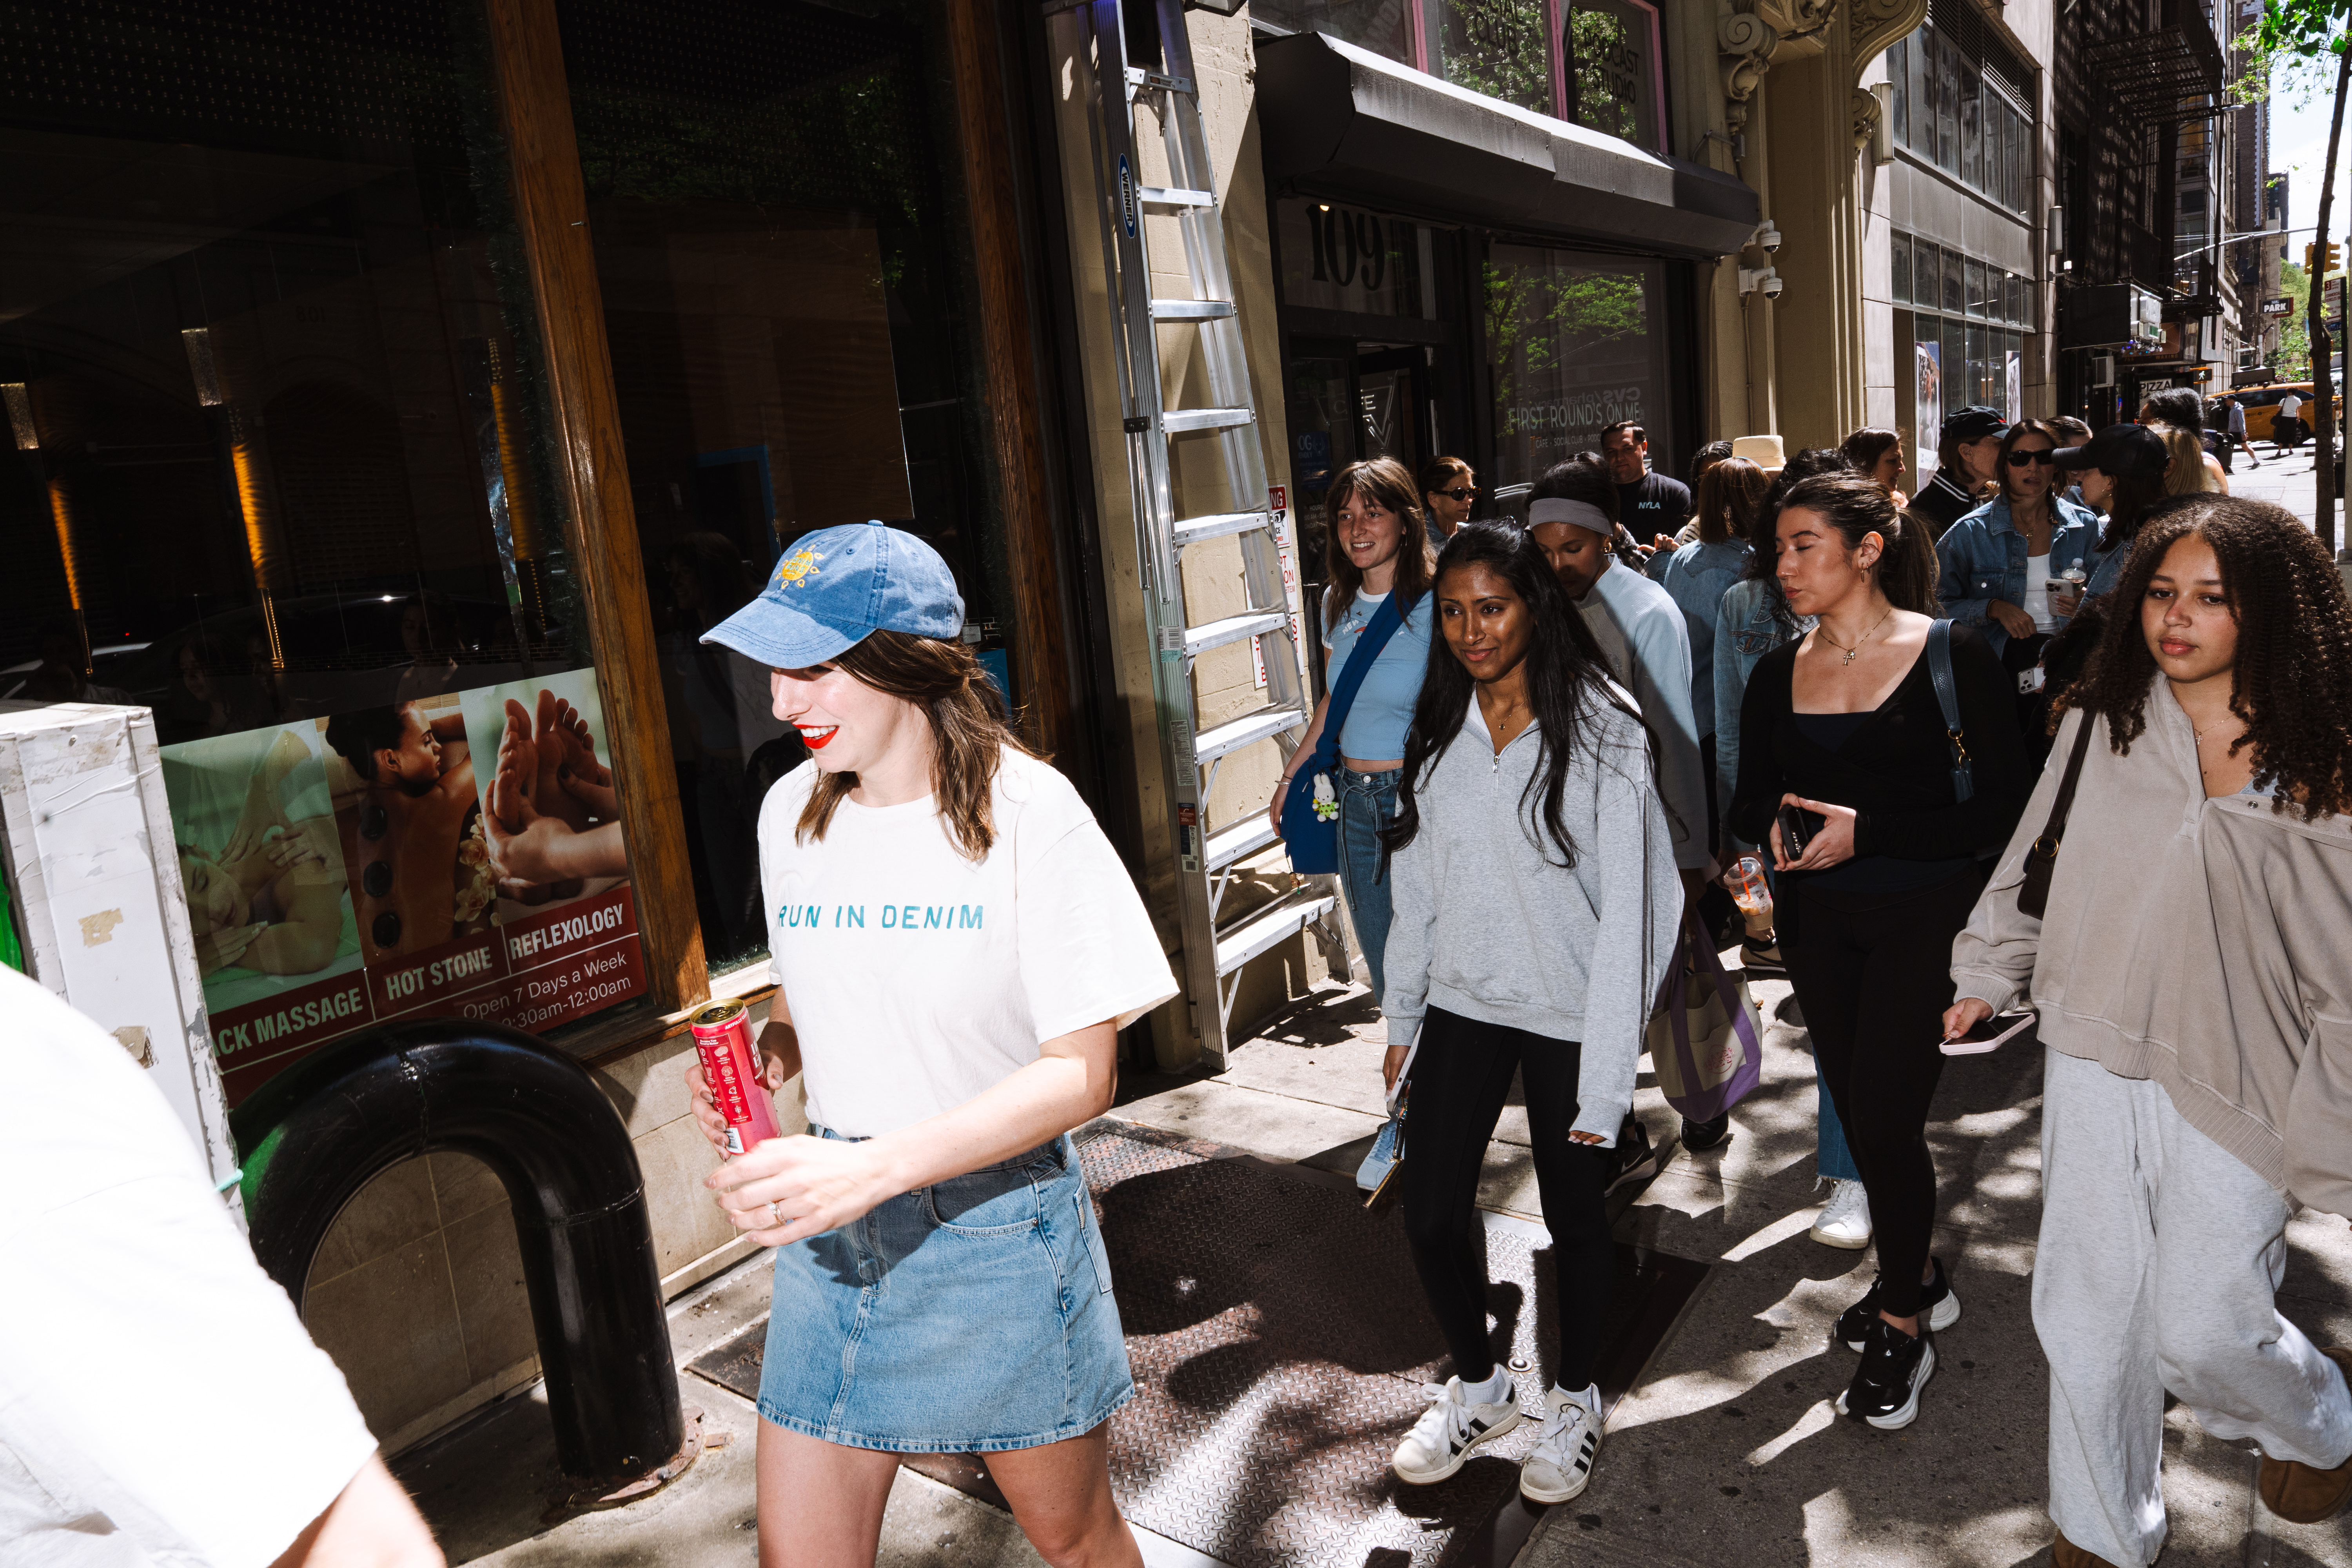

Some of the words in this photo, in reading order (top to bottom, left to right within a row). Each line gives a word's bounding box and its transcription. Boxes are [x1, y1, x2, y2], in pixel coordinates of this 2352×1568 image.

[1475, 11, 1517, 55] CLUB
[1584, 27, 1639, 76] PODCAST
[1593, 64, 1636, 104] STUDIO
[1122, 172, 1133, 222] WERNER
[1306, 204, 1385, 291] 109
[2326, 282, 2330, 290] 3
[2264, 303, 2287, 312] PARK
[2140, 381, 2172, 392] PIZZA
[1508, 406, 1544, 431] FIRST
[1550, 403, 1602, 428] ROUND'S
[1606, 403, 1622, 423] ON
[1626, 402, 1641, 422] ME
[1297, 435, 1312, 451] OG
[1553, 436, 1570, 447] SOCIAL
[1571, 435, 1583, 444] CLUB
[509, 902, 624, 960] REFLEXOLOGY
[779, 904, 822, 928] RUN
[835, 904, 865, 928] IN
[882, 904, 984, 930] DENIM
[385, 966, 425, 1001] HOT
[430, 946, 493, 987] STONE
[463, 993, 510, 1021] Open
[514, 987, 523, 1002] 7
[528, 974, 567, 1000] Days
[572, 969, 581, 982] a
[583, 951, 627, 985] Week
[254, 987, 363, 1044] MASSAGE
